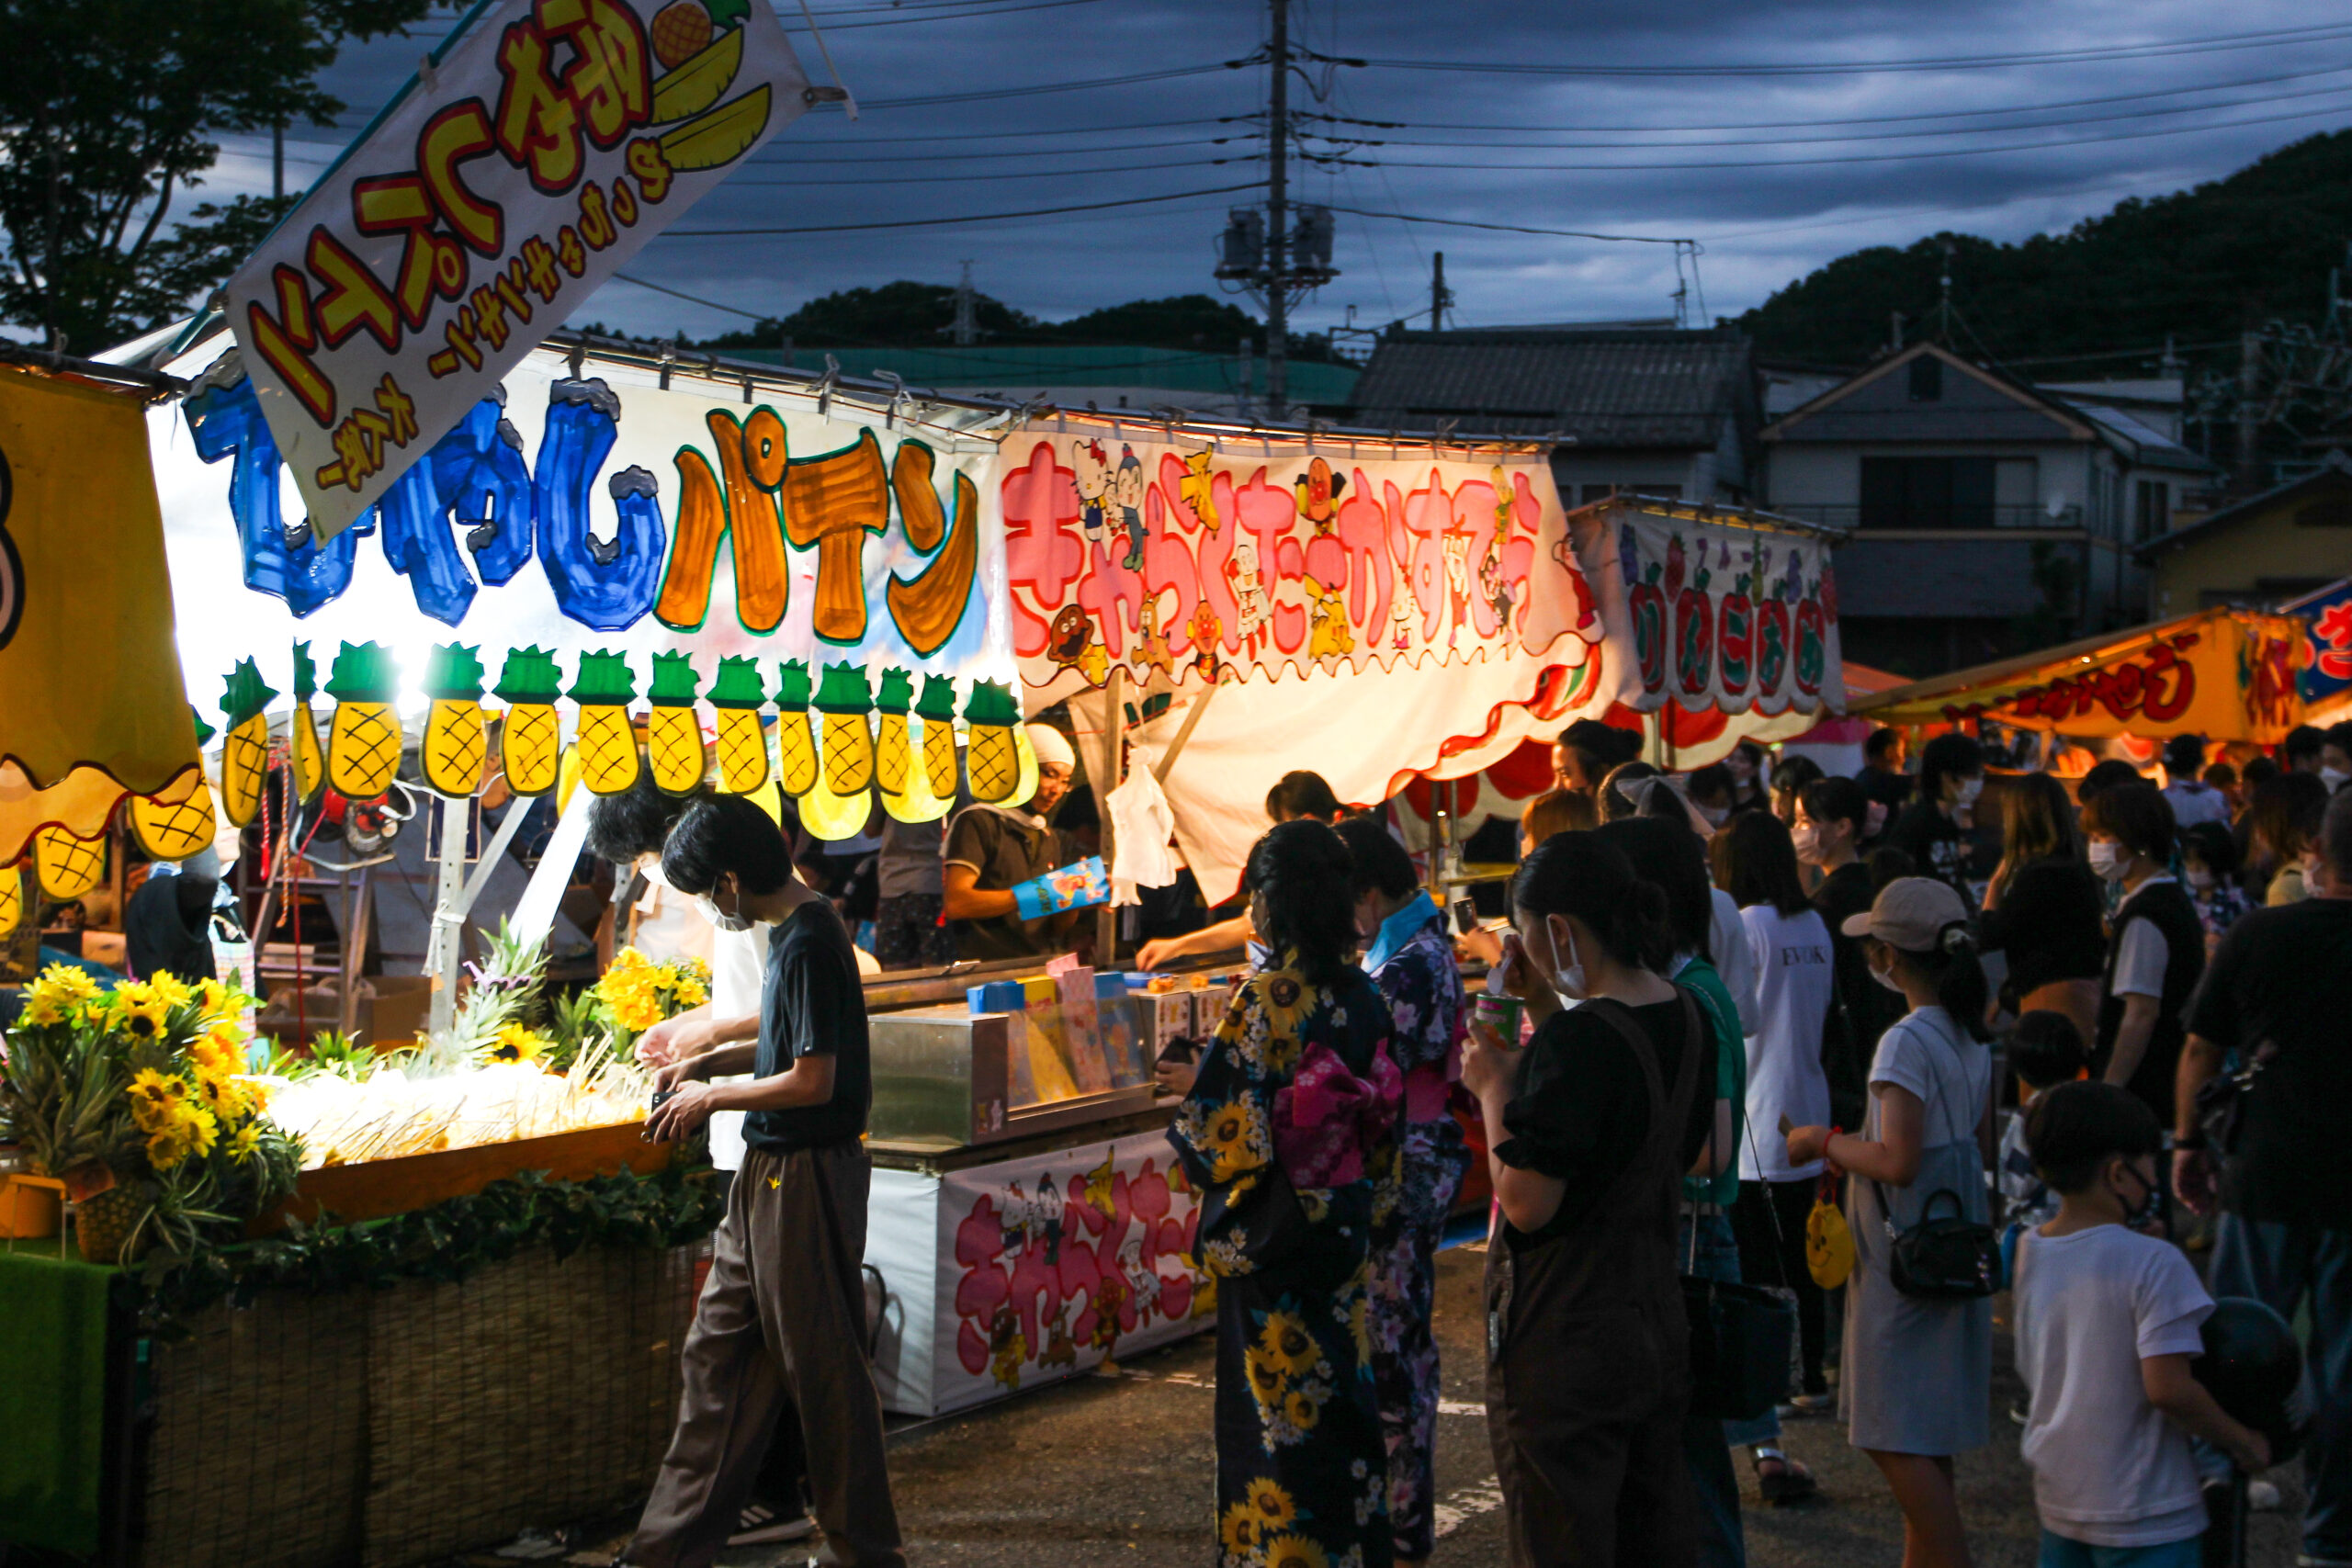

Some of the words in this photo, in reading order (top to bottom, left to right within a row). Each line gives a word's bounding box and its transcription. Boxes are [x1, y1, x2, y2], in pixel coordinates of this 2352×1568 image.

[248, 0, 650, 429] 冷やしパイン
